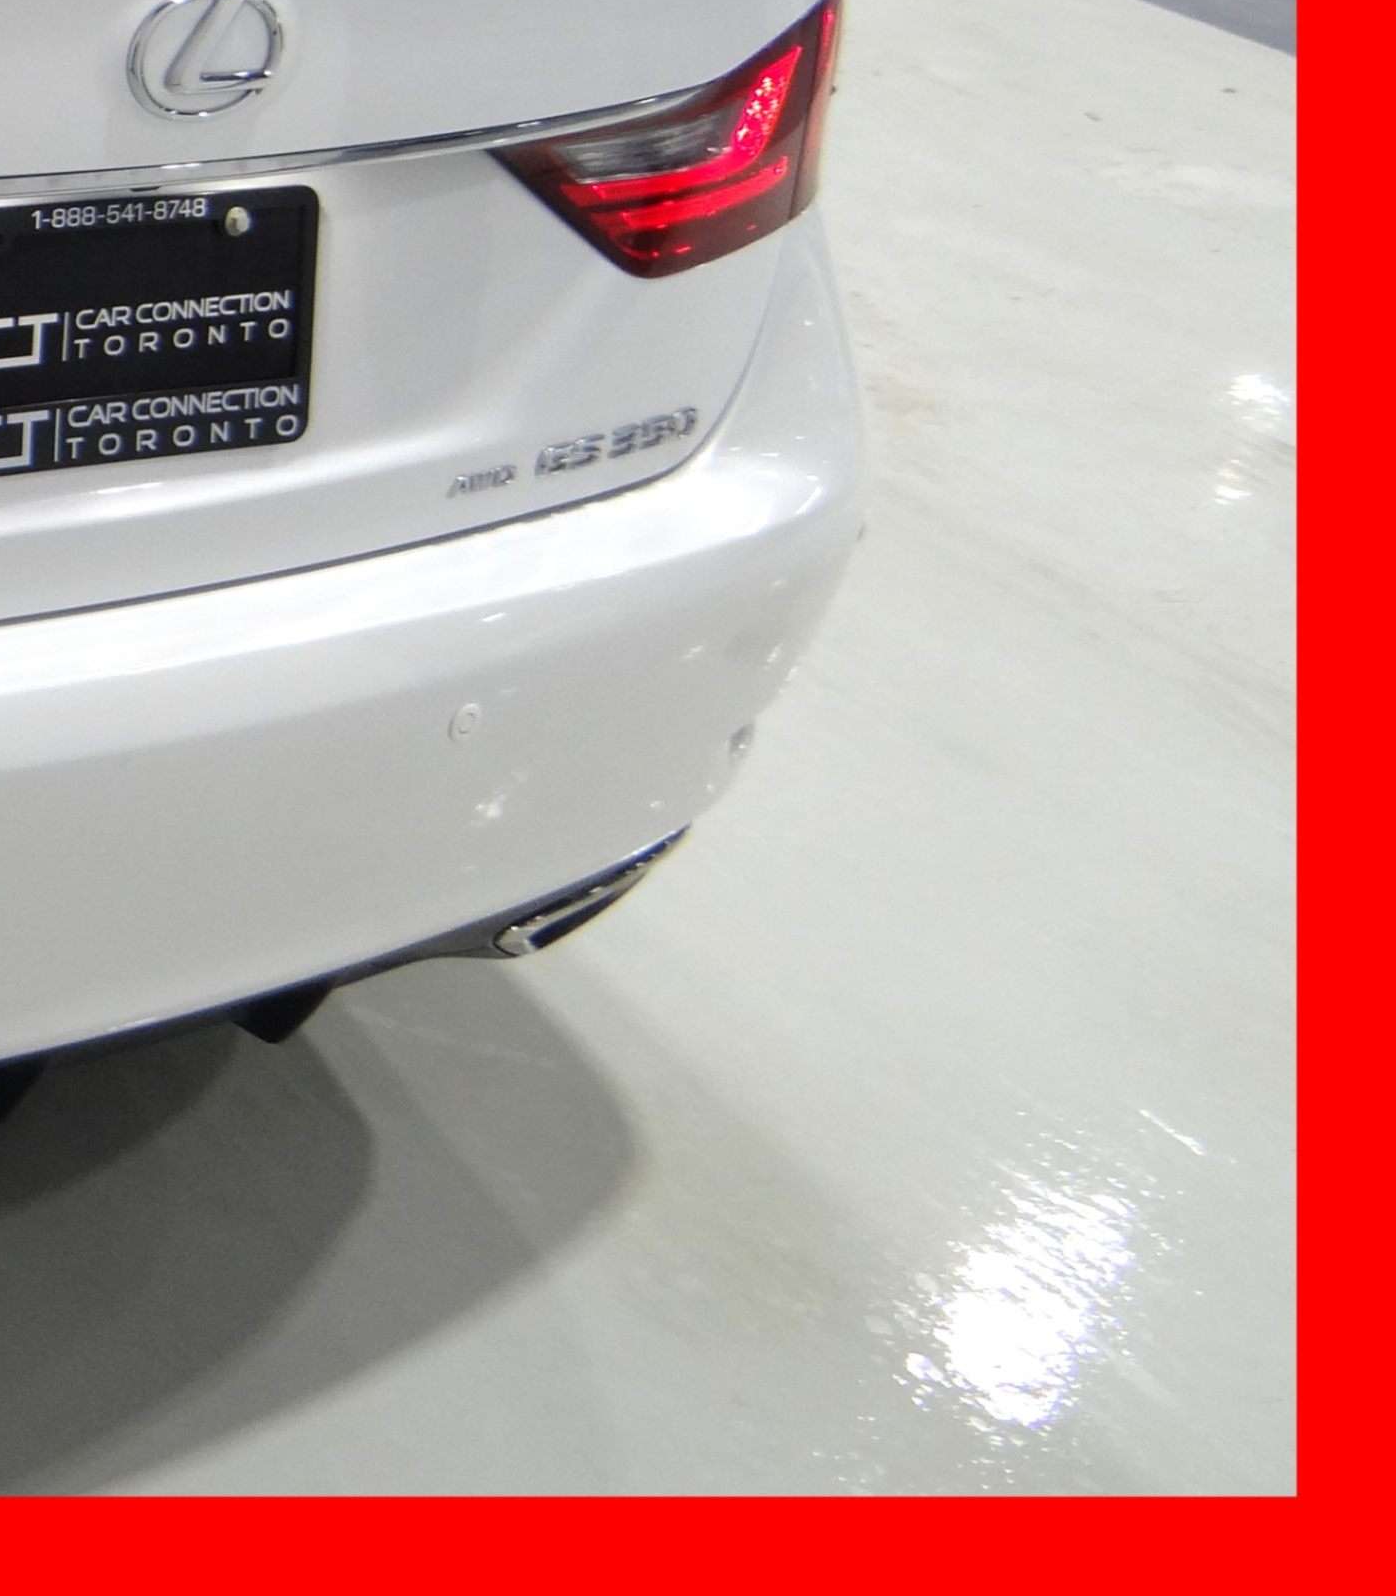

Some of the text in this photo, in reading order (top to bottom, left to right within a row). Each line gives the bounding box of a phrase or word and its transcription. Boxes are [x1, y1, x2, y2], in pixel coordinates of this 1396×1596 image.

[31, 197, 207, 230] 1-888-541-8748
[75, 290, 292, 330] CAR CONNECTION
[73, 317, 291, 360] TORONTO
[67, 384, 300, 428] CAR CONNECTION
[66, 414, 299, 460] TORONTO
